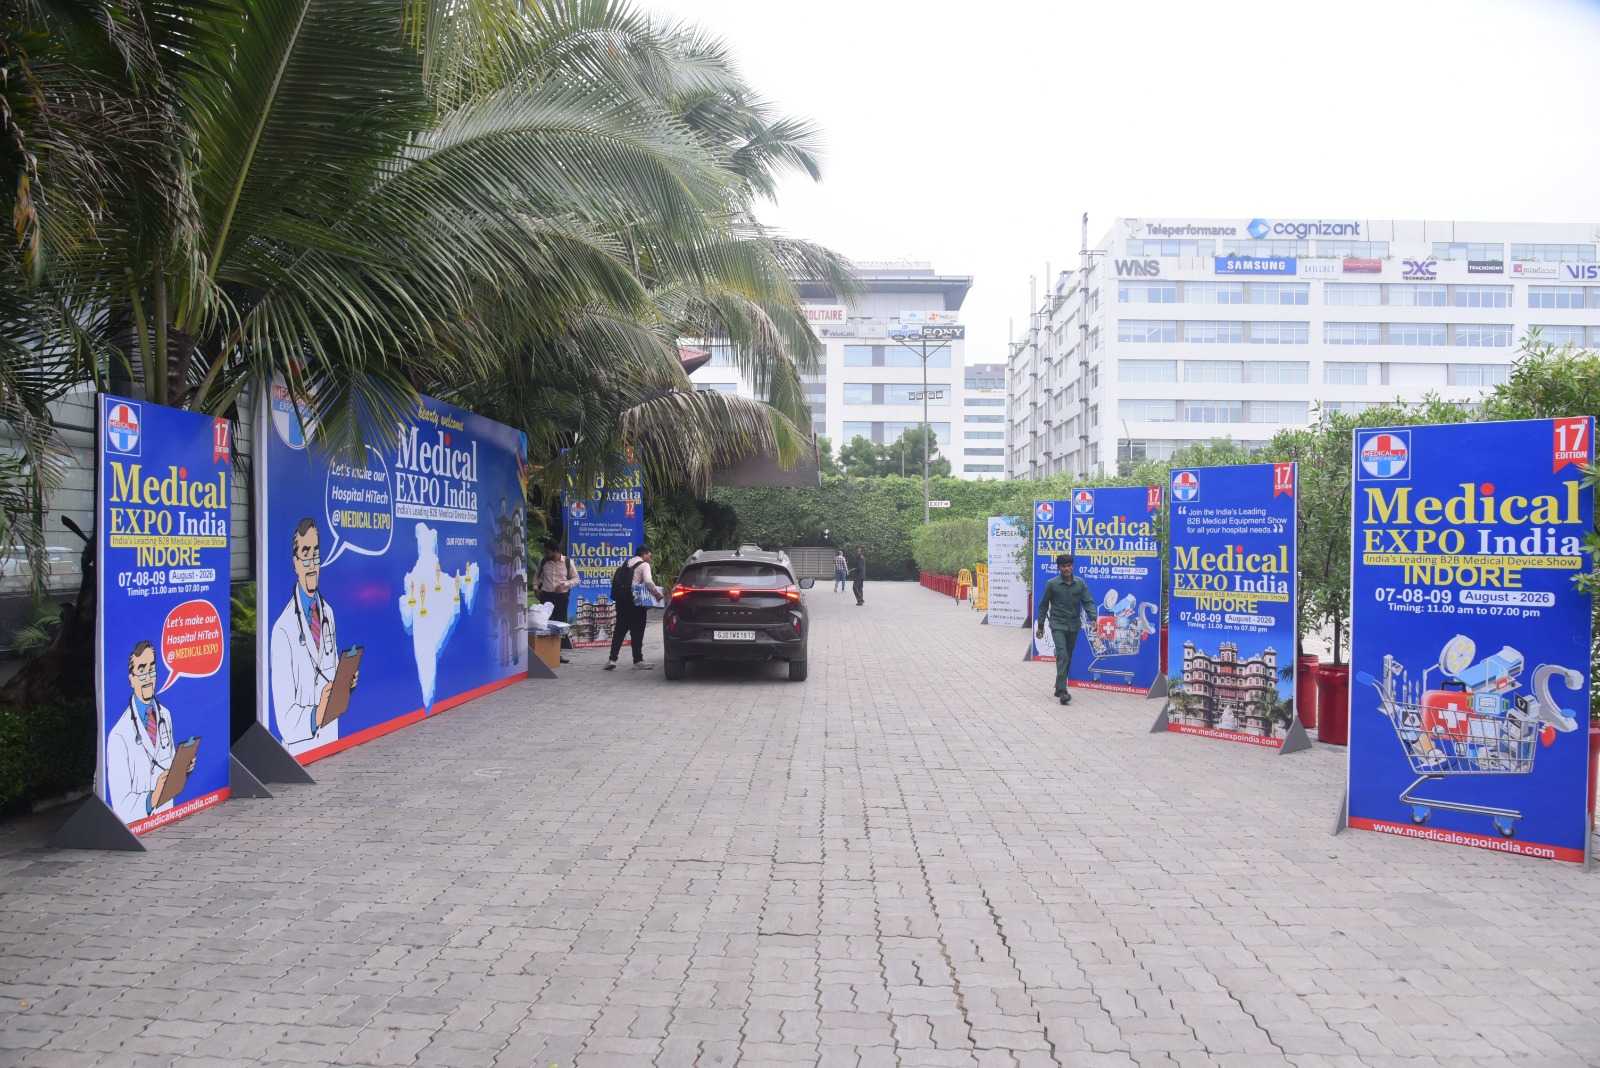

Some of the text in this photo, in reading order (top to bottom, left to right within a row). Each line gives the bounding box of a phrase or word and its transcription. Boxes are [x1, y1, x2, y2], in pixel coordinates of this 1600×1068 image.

[1145, 223, 1236, 237] Teleperformance
[1274, 220, 1360, 240] cognizant
[1114, 259, 1160, 276] WNS
[1226, 260, 1286, 271] SAMSUNG
[1402, 260, 1437, 276] DXC
[923, 328, 963, 337] SONY
[215, 423, 229, 447] 17
[1555, 424, 1586, 450] 17
[395, 422, 478, 482] Medical
[1555, 450, 1588, 460] EDITION
[374, 471, 386, 482] our
[1274, 466, 1291, 485] 17
[110, 461, 227, 509] Medical
[395, 472, 478, 510] EXPO India
[331, 486, 389, 505] Hospital HiTech
[1147, 488, 1160, 502] 17
[1363, 480, 1583, 525] Medical
[1188, 508, 1203, 516] Join
[1215, 507, 1237, 515] India's
[1238, 507, 1266, 516] Leading
[110, 508, 227, 537] EXPO India
[332, 510, 391, 530] @MEDICAL EXPO
[1202, 517, 1228, 525] Medical
[1228, 517, 1265, 526] Equipment
[1266, 516, 1288, 524] Show
[1196, 526, 1205, 534] all
[1206, 527, 1220, 536] your
[1221, 526, 1248, 535] hospital
[571, 542, 633, 557] Medical
[1075, 537, 1157, 551] EXPO India
[1363, 528, 1582, 556] EXPO India
[136, 546, 201, 567] INDORE
[575, 557, 602, 567] XPO
[1090, 555, 1136, 567] INDORE
[1173, 544, 1289, 573] Medical
[1366, 554, 1577, 566] India's Leading B2B Medical Device Show
[1079, 566, 1110, 574] 07-08-09
[1404, 564, 1522, 588] INDORE
[118, 571, 166, 587] 07-08-09
[1174, 573, 1288, 594] EXPO India
[151, 586, 167, 595] 11.00
[1375, 587, 1452, 604] 07-08-09
[1464, 591, 1510, 603] August
[1520, 592, 1550, 603] 2026
[1195, 597, 1259, 614] INDORE
[1388, 602, 1425, 614] Timing:
[1427, 604, 1455, 613] 11.00
[1476, 607, 1488, 615] to
[1489, 607, 1520, 616] 07.00
[1522, 609, 1540, 618] pm
[167, 615, 217, 629] Let's make our
[1180, 611, 1221, 623] 07-08-09
[167, 629, 220, 645] Hospital HiTech
[203, 643, 219, 655] EXPO
[1180, 725, 1279, 746] www.medicalexpoindia.com
[1373, 822, 1555, 858] www.medicalexpoindia.com
